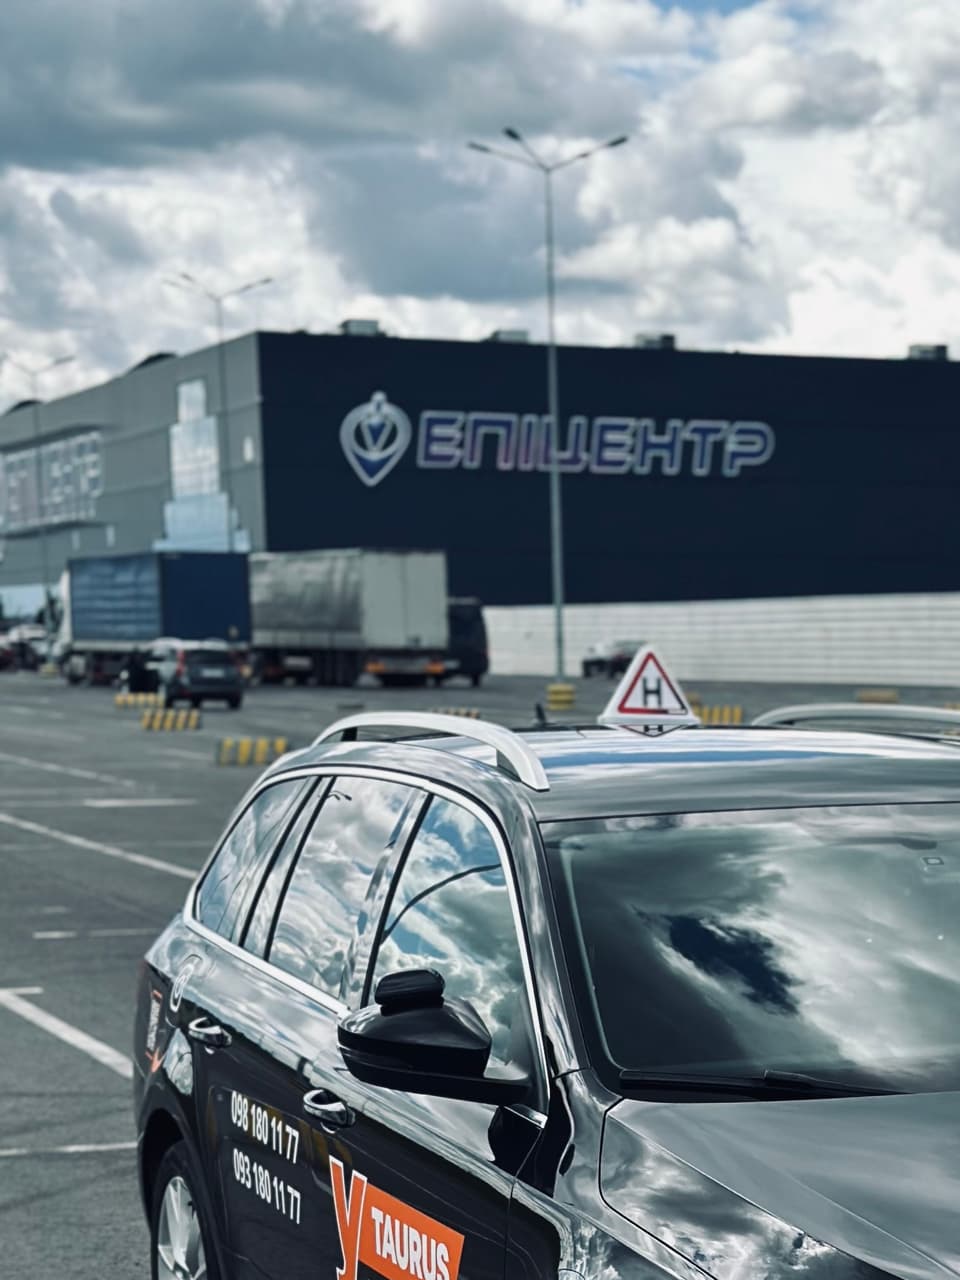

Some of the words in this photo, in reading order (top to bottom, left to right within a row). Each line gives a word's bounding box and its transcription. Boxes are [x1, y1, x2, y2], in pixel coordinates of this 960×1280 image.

[416, 410, 776, 477] ЕПІЦЕНТР
[231, 1090, 248, 1132] 098
[251, 1103, 269, 1145] 180
[271, 1116, 282, 1155] 11
[285, 1124, 299, 1164] 77
[233, 1147, 251, 1189] 093
[252, 1161, 271, 1204] 180
[273, 1176, 286, 1215] 11
[287, 1184, 301, 1225] 77
